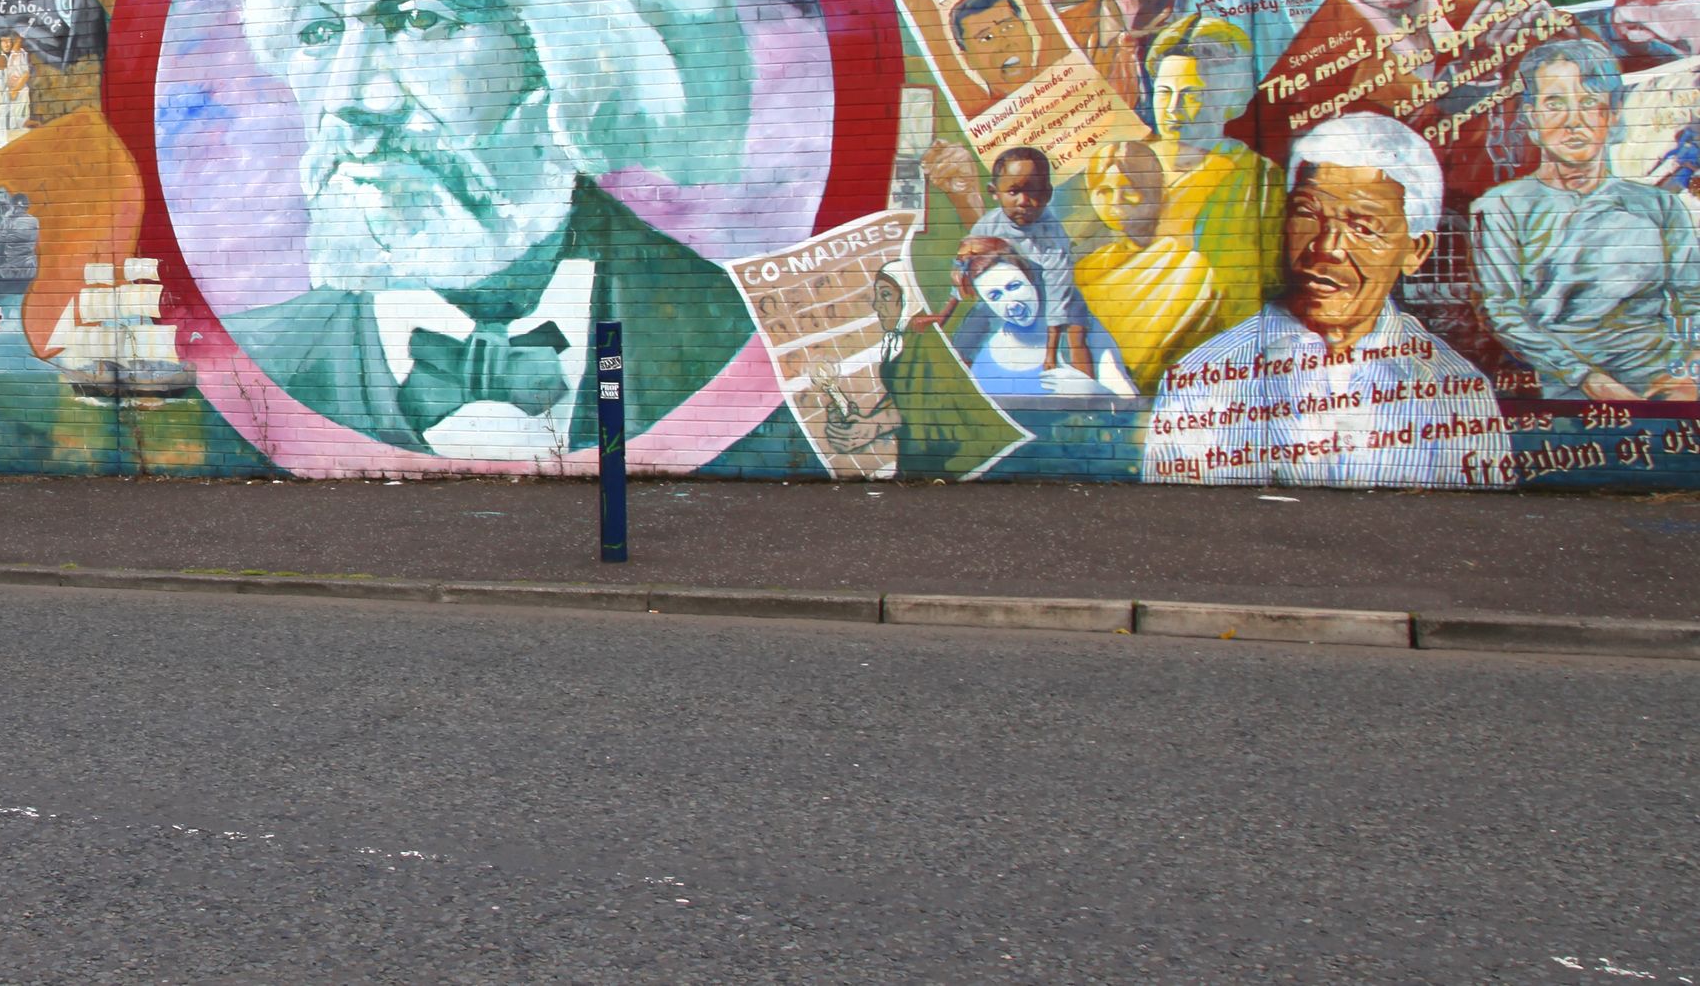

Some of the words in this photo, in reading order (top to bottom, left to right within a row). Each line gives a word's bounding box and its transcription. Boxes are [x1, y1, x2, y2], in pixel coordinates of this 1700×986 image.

[9, 0, 62, 33] chariot
[1257, 71, 1309, 103] The
[1315, 38, 1372, 82] most
[1394, 101, 1412, 117] is
[1412, 78, 1449, 109] the
[1450, 46, 1503, 87] mind
[1506, 28, 1530, 55] of
[1535, 11, 1575, 38] the
[992, 106, 1014, 126] should
[1019, 94, 1034, 108] drop
[1034, 74, 1063, 96] bombs
[1288, 82, 1374, 129] weapon
[1374, 63, 1396, 86] of
[977, 136, 1001, 154] brown
[1002, 120, 1024, 142] people
[743, 220, 903, 285] CO-MADRES
[1166, 364, 1196, 391] For
[1201, 362, 1220, 385] to
[1225, 359, 1248, 380] be
[1254, 353, 1293, 378] free
[1301, 353, 1317, 371] is
[1323, 346, 1355, 364] not
[1362, 337, 1433, 362] merely
[1154, 415, 1172, 434] to
[1178, 408, 1215, 429] cast
[1219, 402, 1245, 425] off
[1297, 390, 1361, 414] chains
[1371, 380, 1406, 404] but
[1413, 382, 1437, 399] to
[1443, 375, 1485, 394] live
[1156, 457, 1200, 480] way
[1205, 440, 1252, 469] that
[1367, 422, 1412, 448] and
[1421, 412, 1553, 439] enhances
